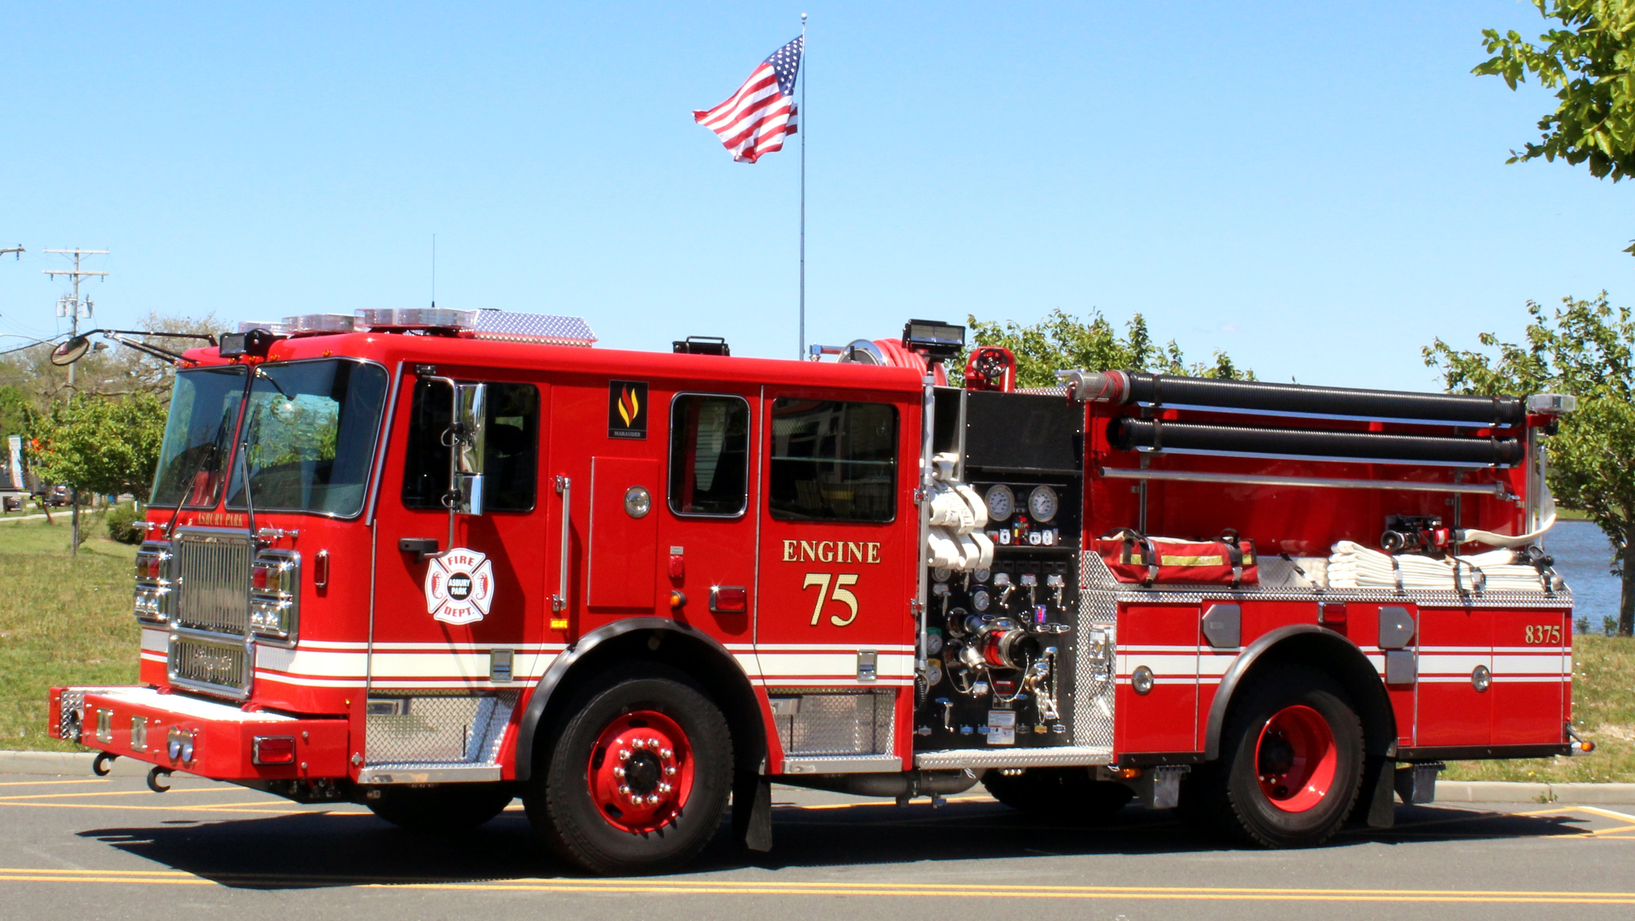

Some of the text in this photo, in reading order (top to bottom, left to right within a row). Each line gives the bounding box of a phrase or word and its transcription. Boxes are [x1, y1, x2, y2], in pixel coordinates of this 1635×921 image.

[225, 513, 244, 527] PARK
[782, 539, 881, 564] ENGINE
[447, 555, 475, 566] FIRE
[448, 578, 471, 587] ASBURY
[451, 587, 468, 595] PARK
[802, 573, 860, 628] 75
[443, 606, 475, 618] DEPT.
[1525, 624, 1561, 644] 8375
